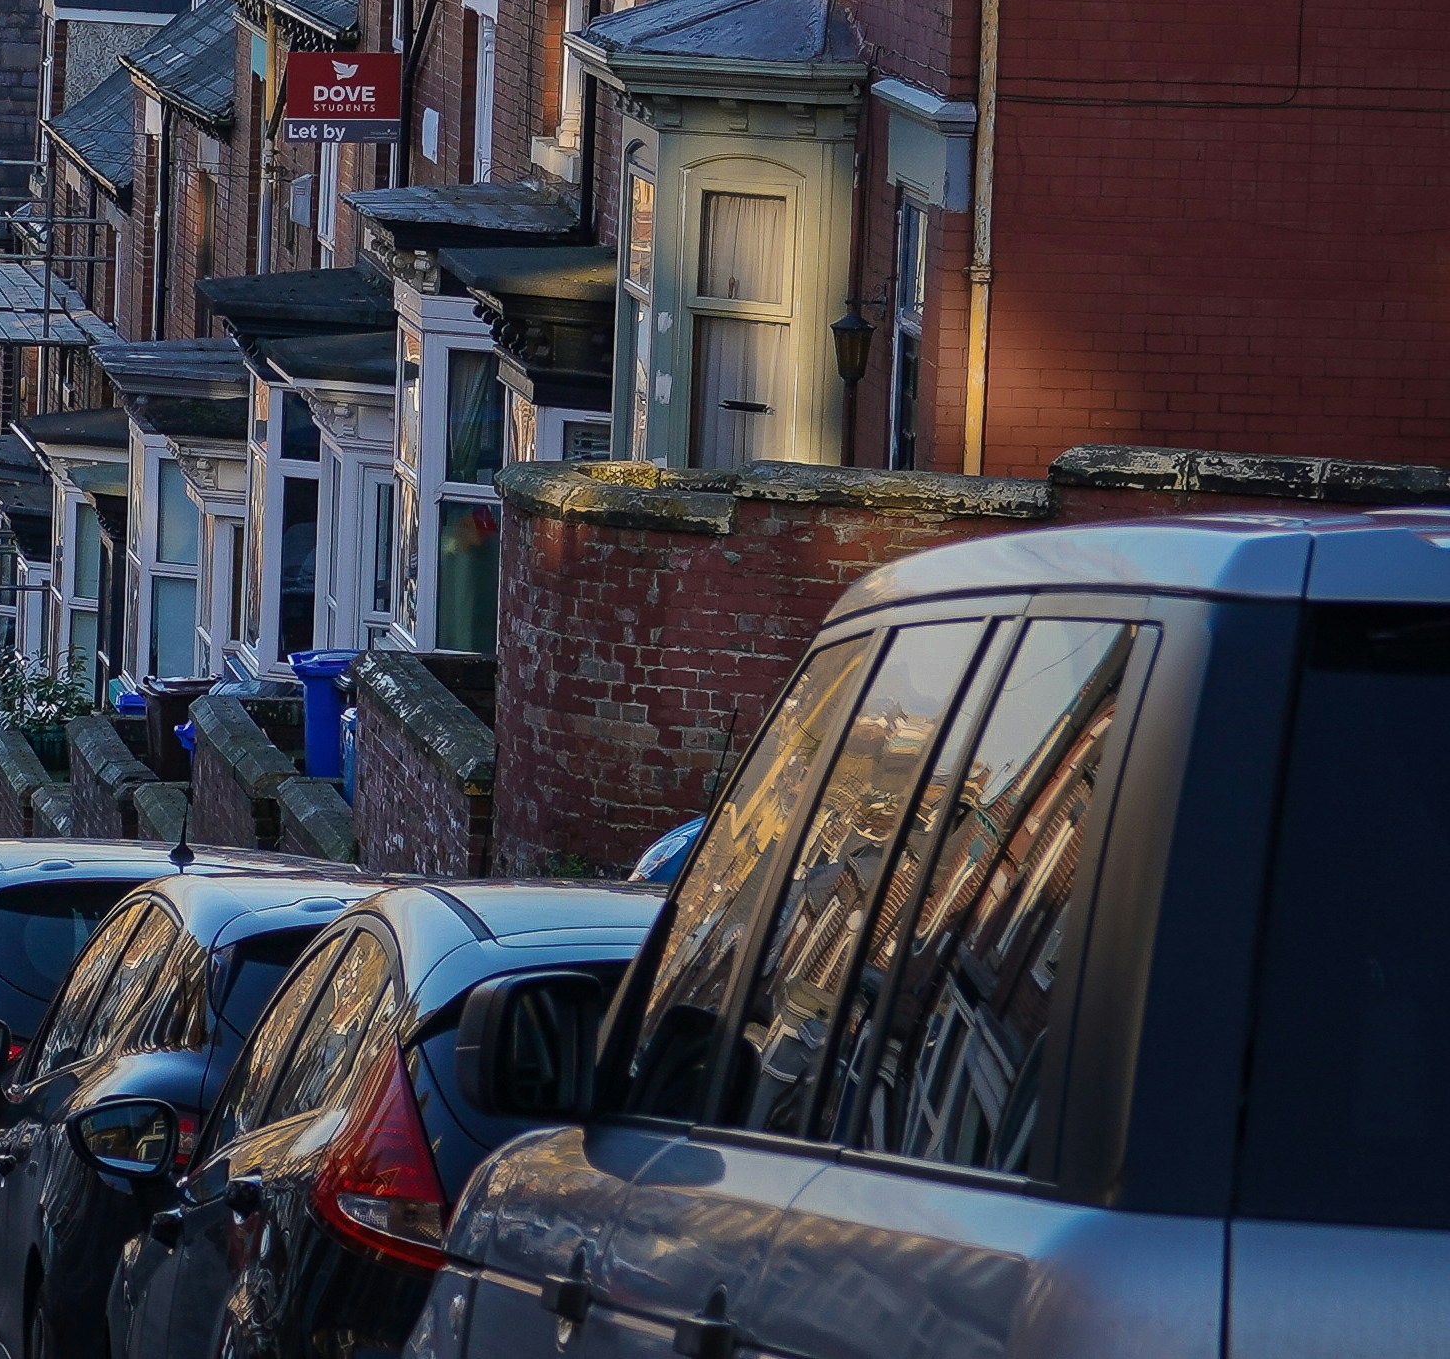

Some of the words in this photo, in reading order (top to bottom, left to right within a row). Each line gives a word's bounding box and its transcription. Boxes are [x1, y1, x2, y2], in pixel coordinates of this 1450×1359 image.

[313, 85, 376, 102] DOVE
[313, 103, 376, 113] STUDENTS
[288, 124, 318, 139] Let
[323, 124, 346, 142] by
